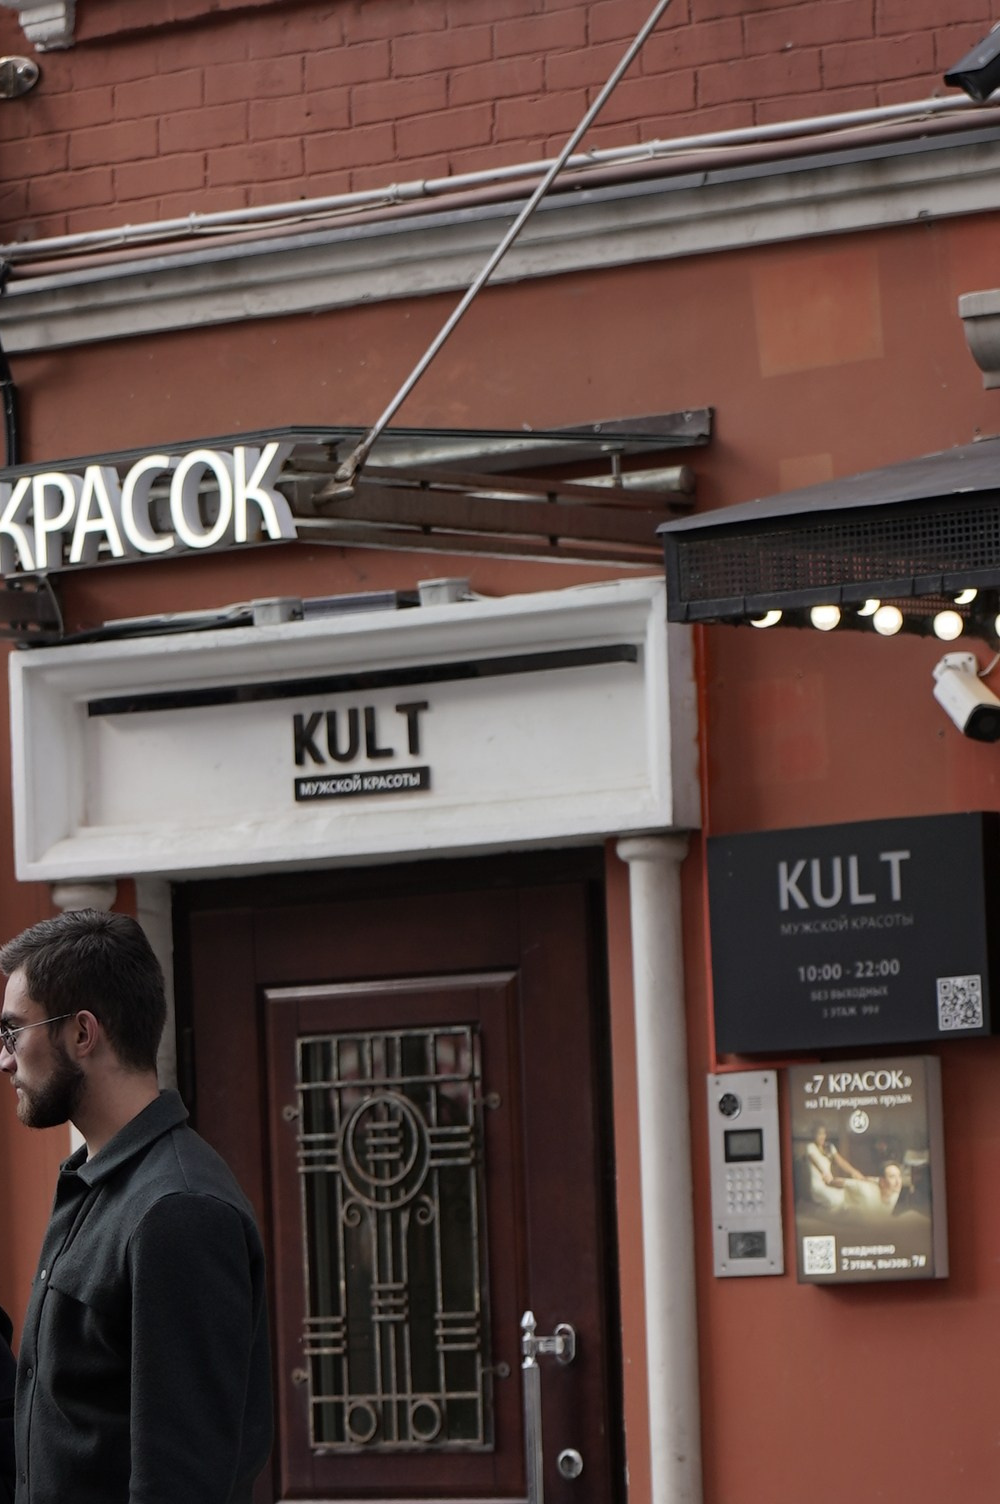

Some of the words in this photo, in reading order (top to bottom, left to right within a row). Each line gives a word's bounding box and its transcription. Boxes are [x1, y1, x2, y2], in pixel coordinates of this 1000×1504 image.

[293, 701, 429, 766] KULT
[300, 774, 362, 796] МУЖСКОЙ
[362, 772, 421, 791] КРАСОТЫ
[778, 850, 911, 911] KULT
[799, 963, 842, 982] 10:00
[855, 958, 900, 978] 22:00
